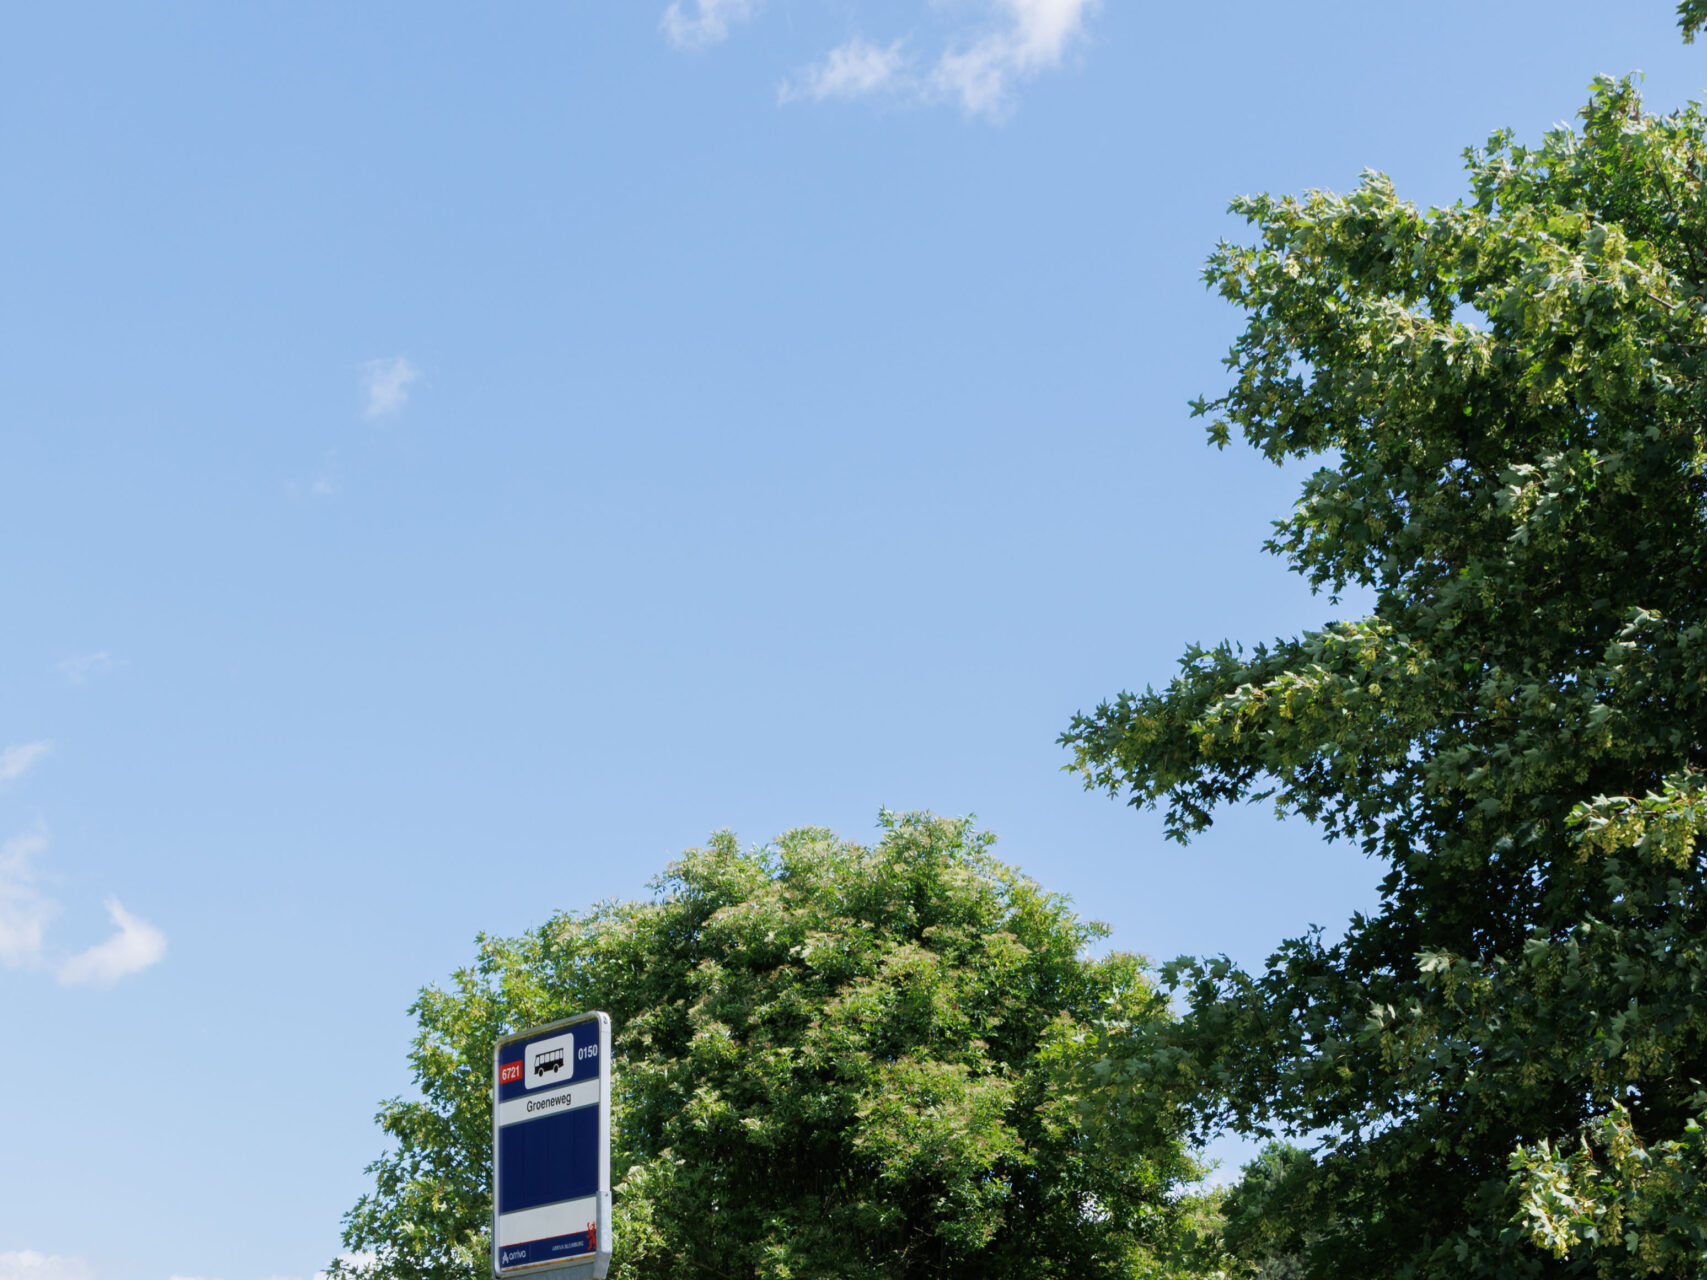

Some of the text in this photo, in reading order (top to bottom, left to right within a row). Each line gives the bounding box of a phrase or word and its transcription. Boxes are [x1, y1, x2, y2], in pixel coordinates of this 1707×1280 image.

[578, 1044, 598, 1061] 0150
[501, 1065, 520, 1081] 6721
[526, 1093, 571, 1113] Groeneweg
